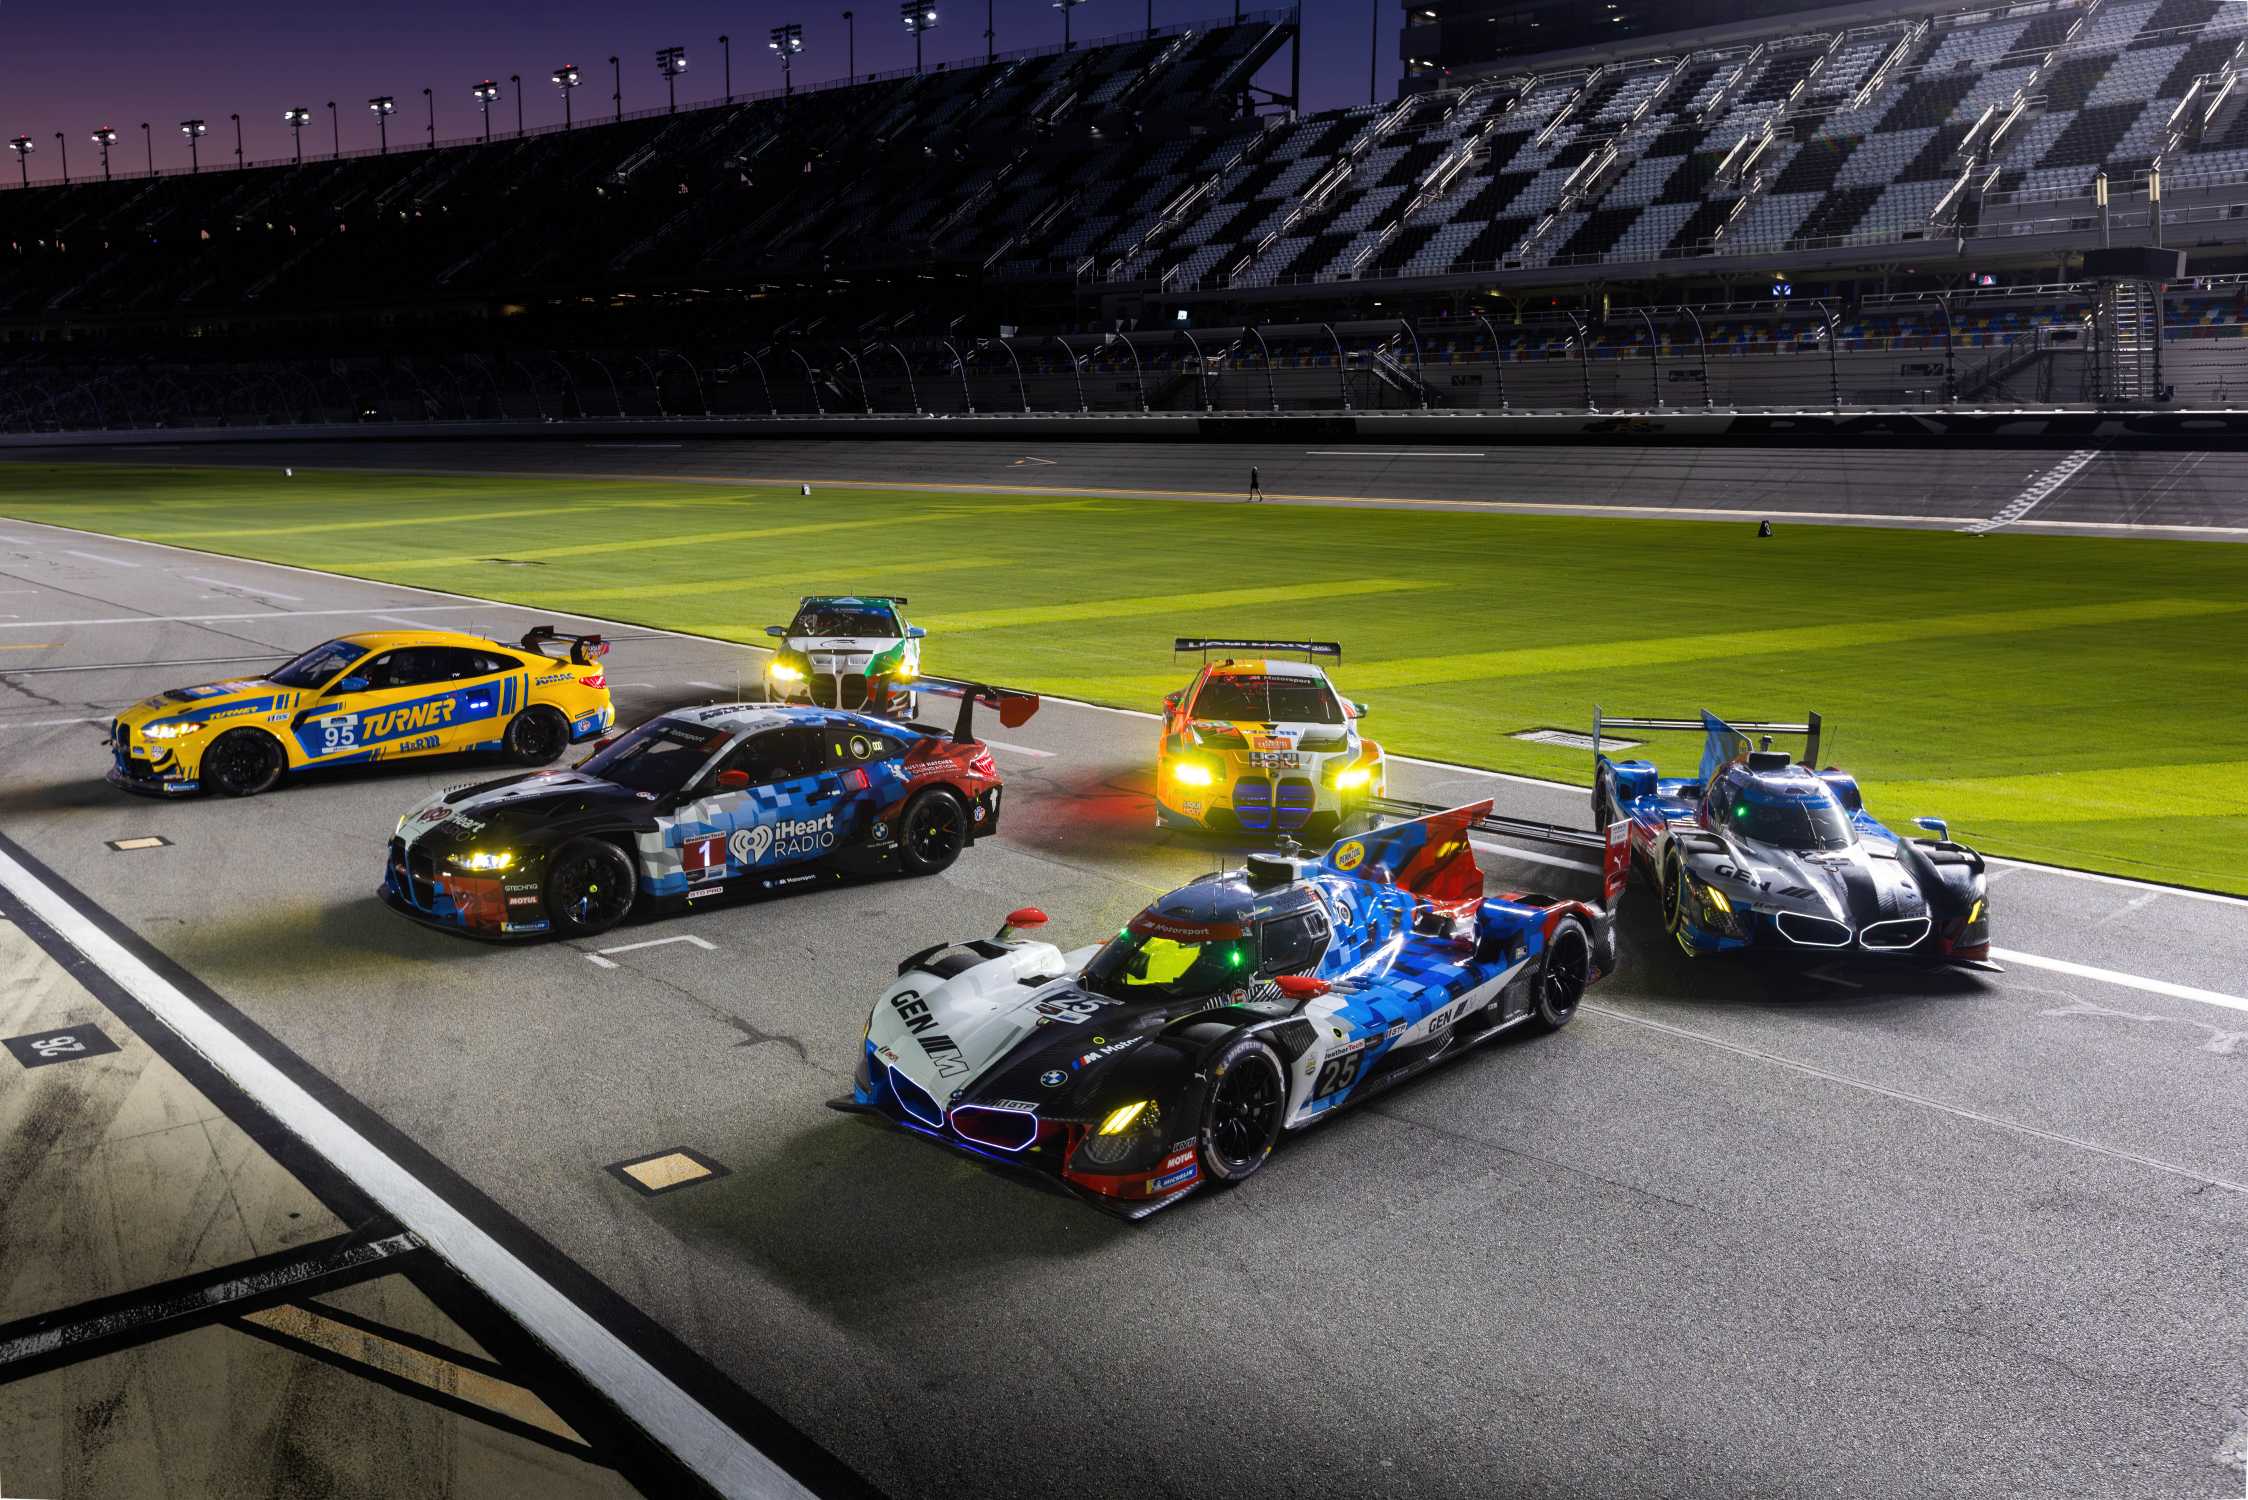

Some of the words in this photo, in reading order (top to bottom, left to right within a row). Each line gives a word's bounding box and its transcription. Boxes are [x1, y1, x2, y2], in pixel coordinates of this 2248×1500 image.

[1264, 676, 1311, 685] Motorsport
[362, 698, 456, 740] TURNER
[324, 726, 354, 748] 95
[775, 814, 834, 840] iHeart
[699, 841, 711, 868] 1
[774, 832, 834, 858] RADIO
[510, 896, 538, 905] MOTUL
[1154, 924, 1210, 935] Motorsport
[890, 989, 939, 1035] GEN
[1050, 992, 1108, 1013] 25
[1429, 1009, 1453, 1034] GEN
[1320, 1054, 1357, 1097] 25
[1167, 1151, 1193, 1168] MOTUL
